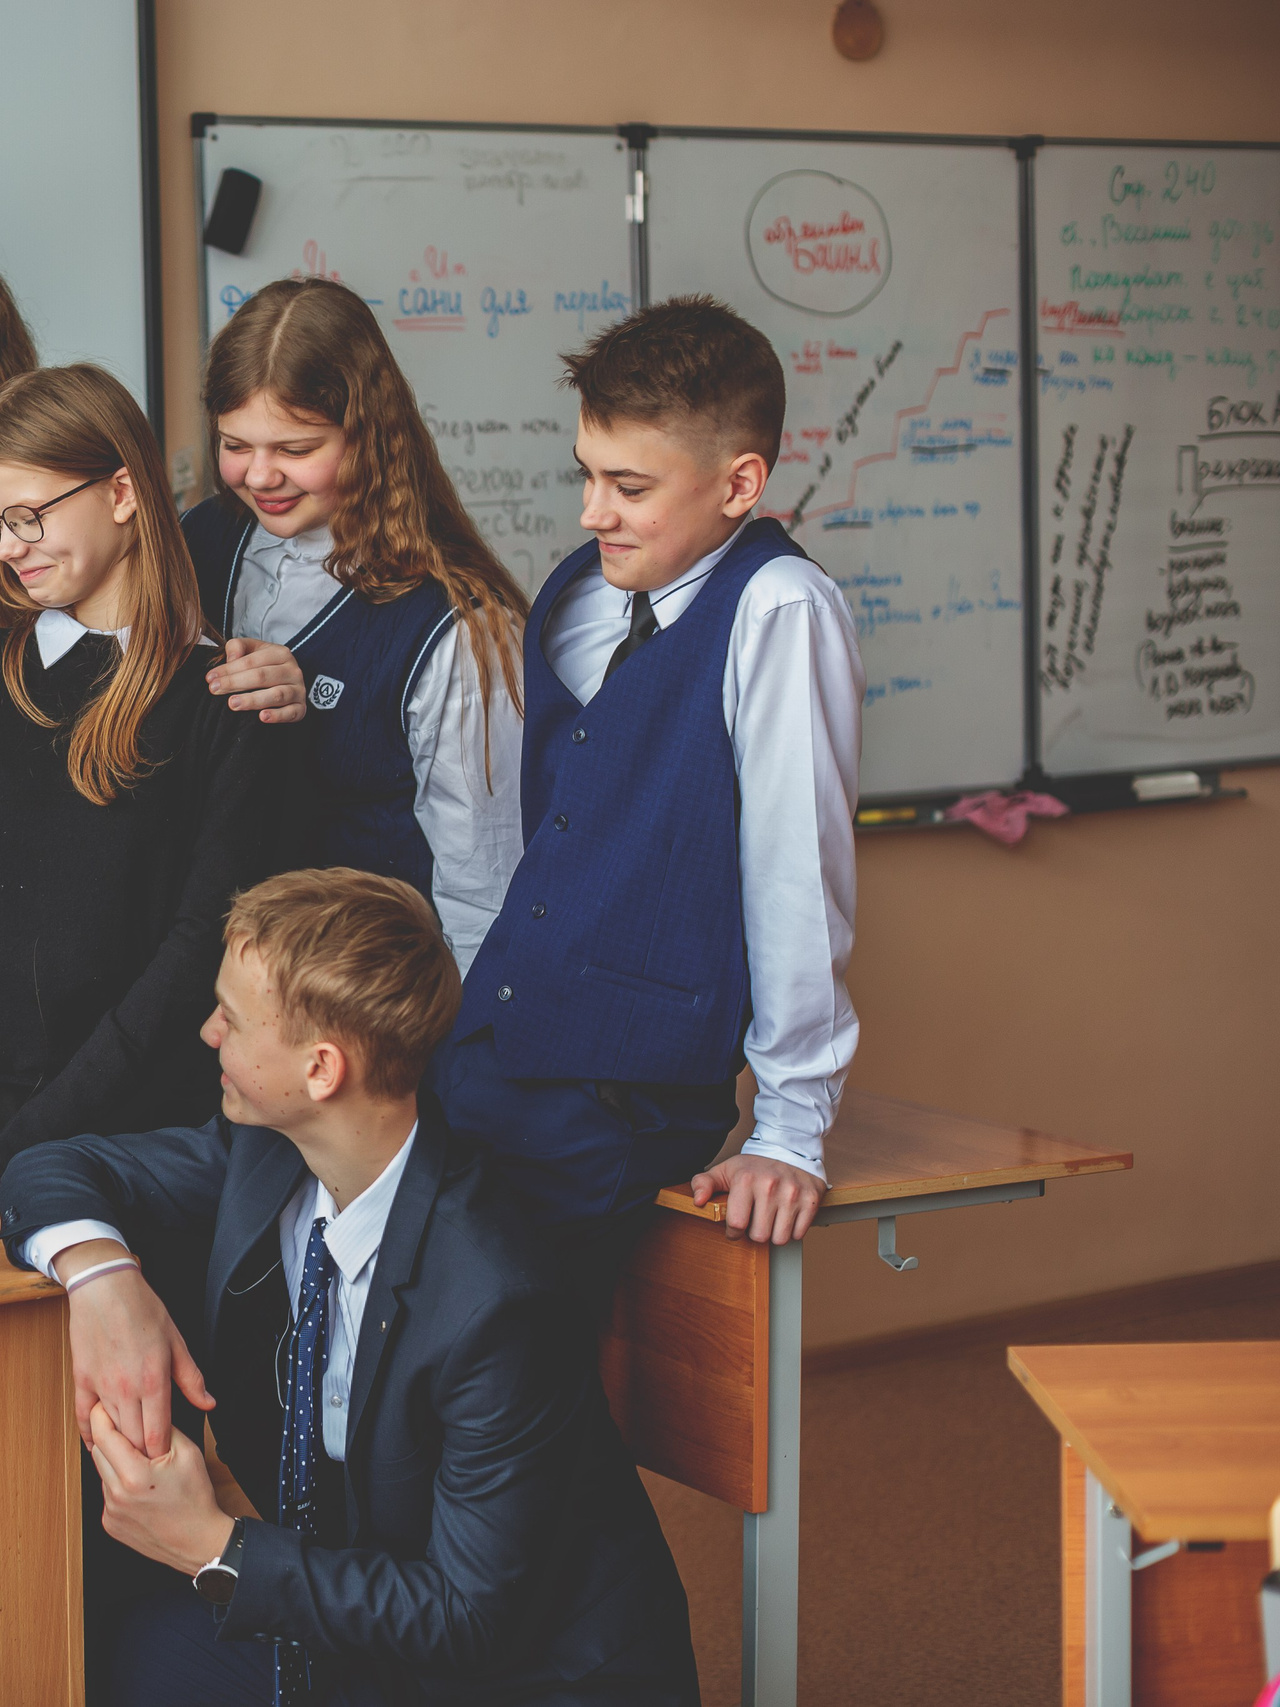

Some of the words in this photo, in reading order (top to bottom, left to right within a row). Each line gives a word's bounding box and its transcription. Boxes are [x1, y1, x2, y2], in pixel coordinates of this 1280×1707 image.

[1162, 160, 1217, 205] 240
[398, 287, 463, 317] сани
[480, 286, 535, 339] для
